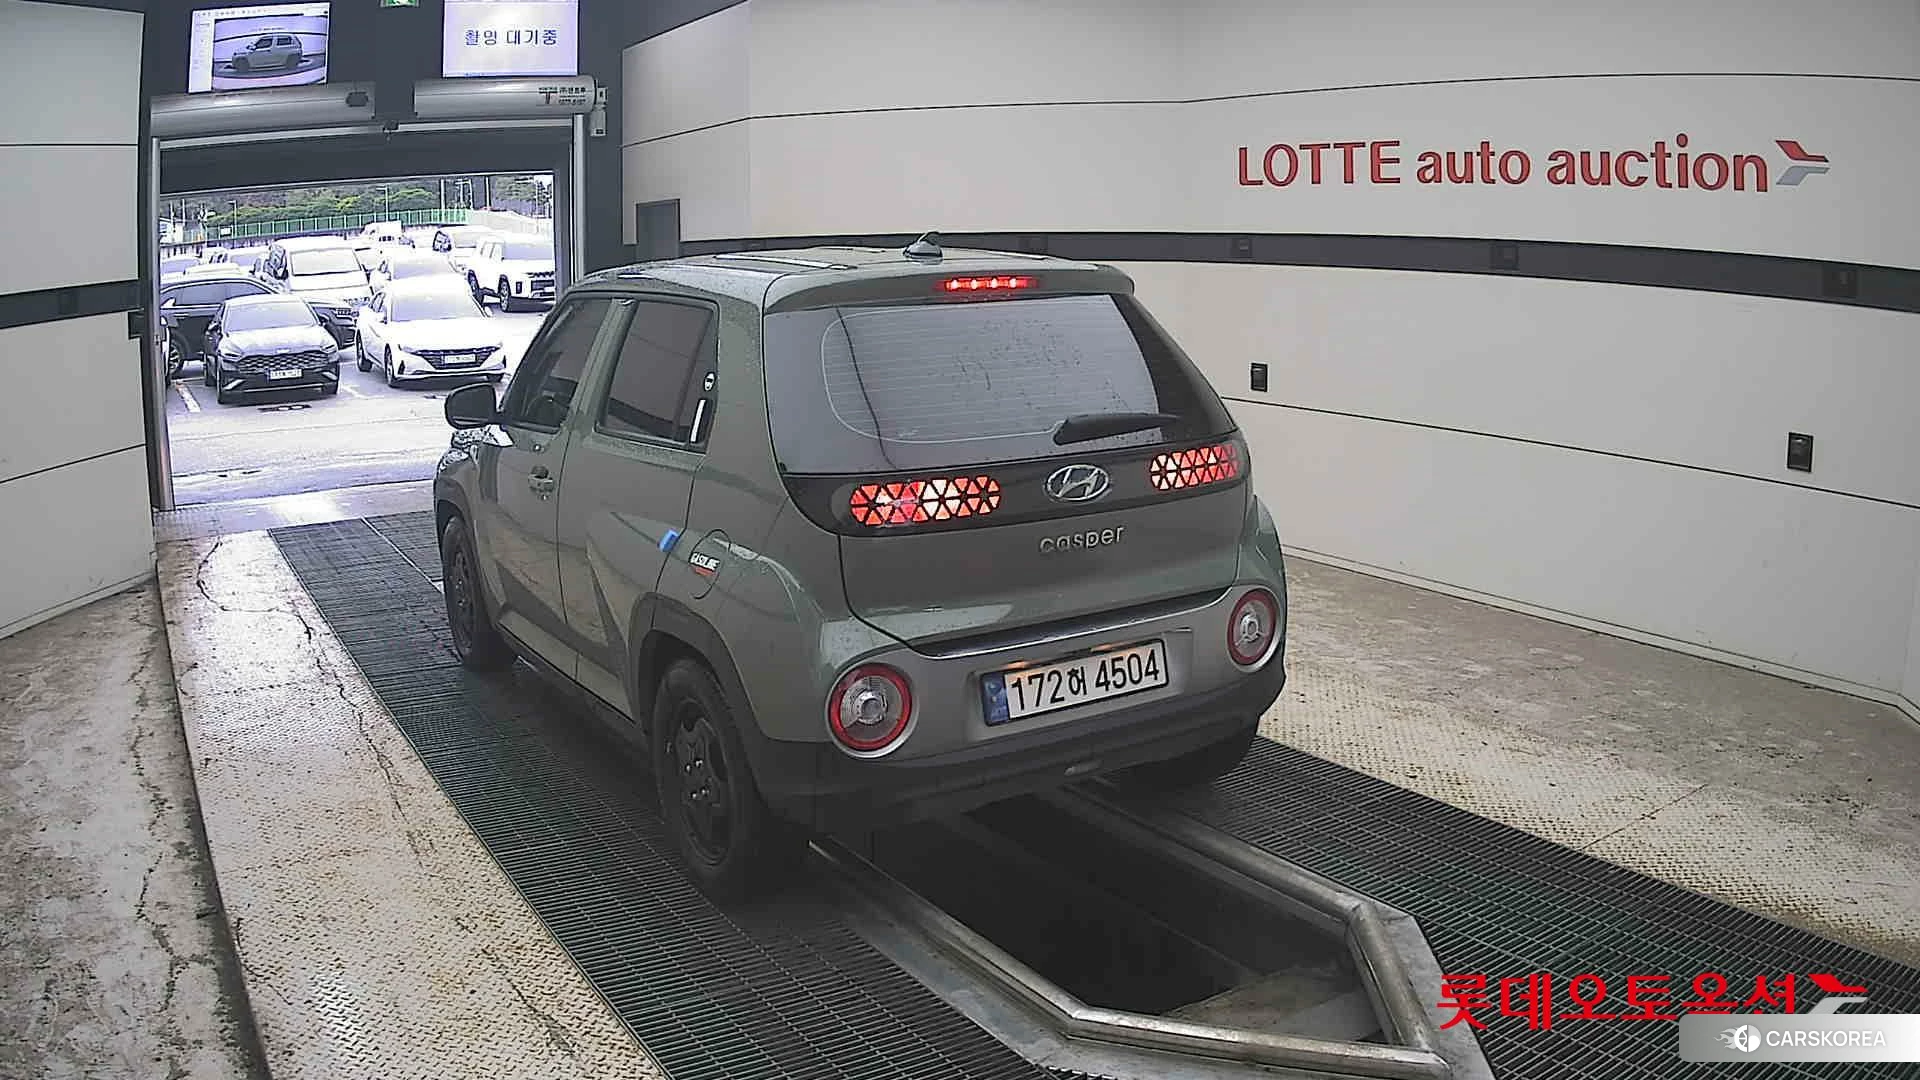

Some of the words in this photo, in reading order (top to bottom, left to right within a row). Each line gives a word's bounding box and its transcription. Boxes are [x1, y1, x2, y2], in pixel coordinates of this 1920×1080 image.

[506, 29, 558, 46] 대기중
[1238, 140, 1401, 187] LOTTE
[1416, 140, 1531, 186] auto
[1546, 133, 1769, 193] auction
[1040, 526, 1125, 552] casper
[1011, 666, 1088, 711] 172허
[1095, 648, 1160, 692] 4504
